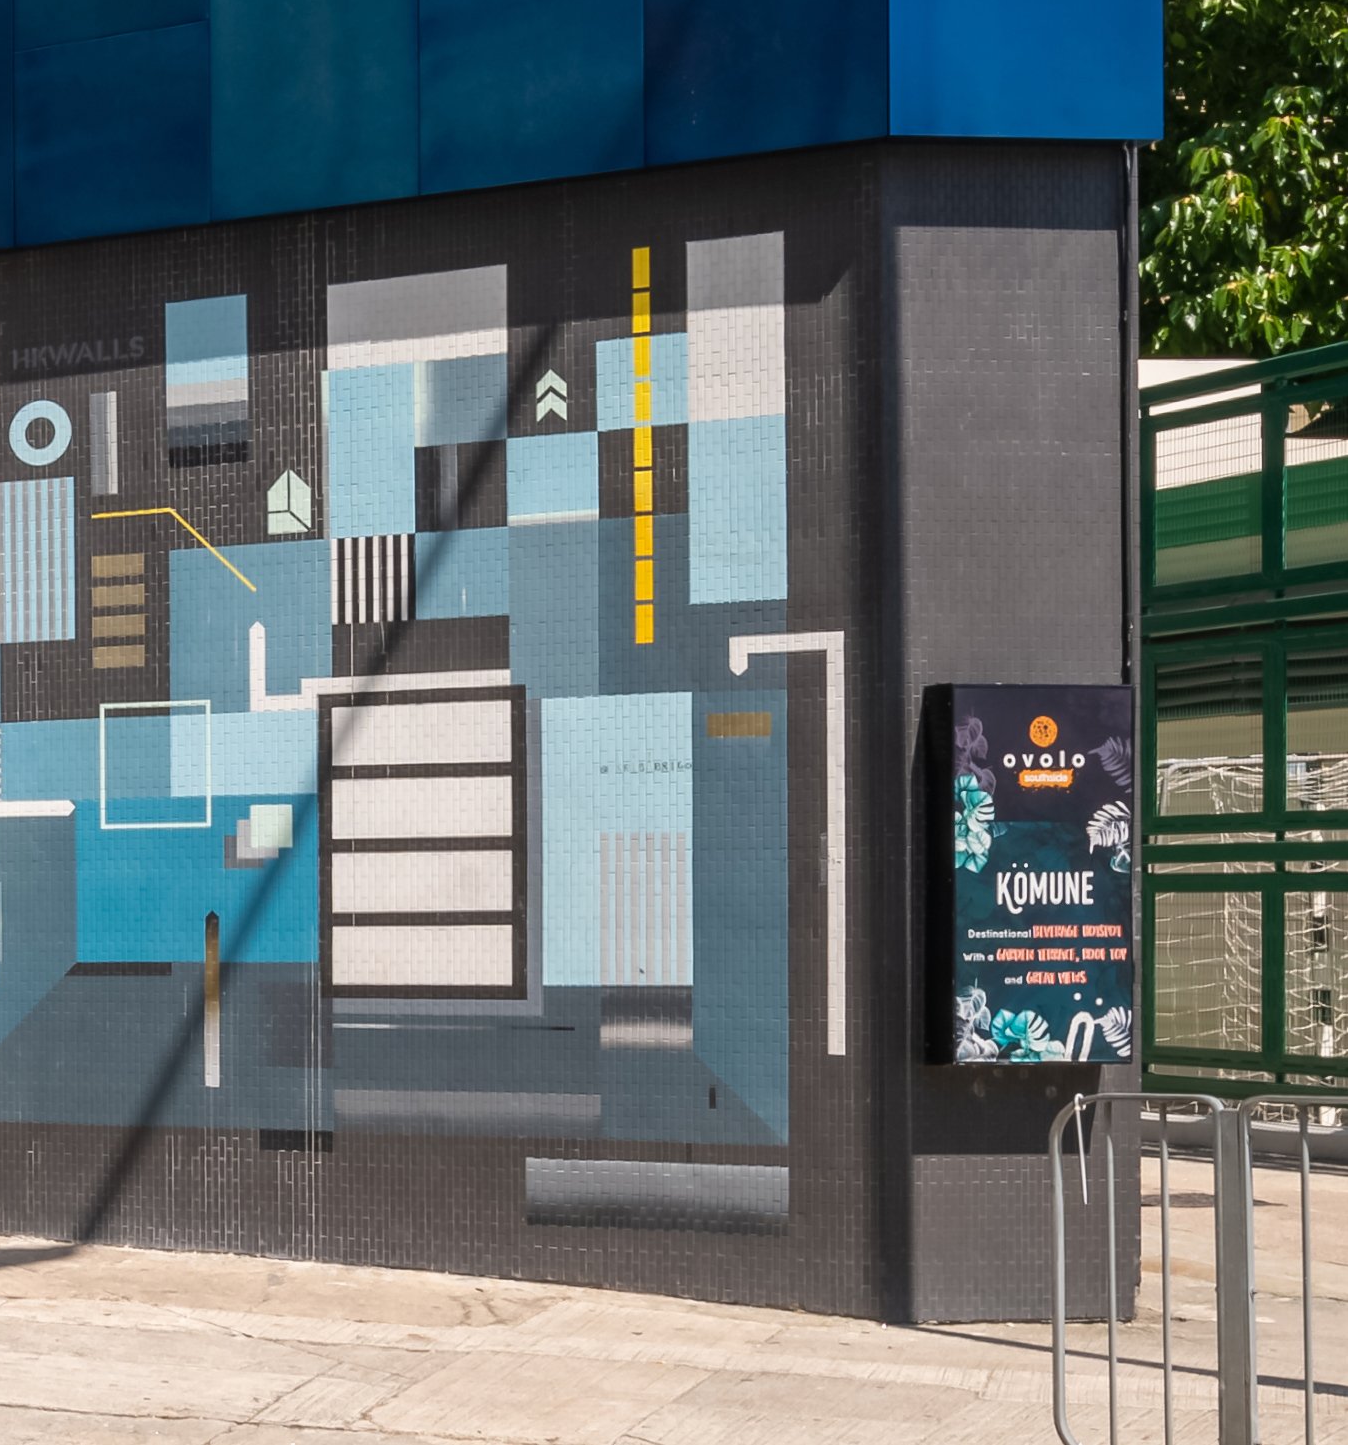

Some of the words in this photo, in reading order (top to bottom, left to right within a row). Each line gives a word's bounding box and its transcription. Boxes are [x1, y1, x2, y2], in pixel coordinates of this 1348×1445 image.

[12, 335, 145, 371] HKWALLS
[1003, 749, 1086, 768] ovolo
[997, 862, 1094, 914] KÖMUNE
[968, 928, 1032, 939] Destinational
[987, 954, 994, 962] a
[1004, 975, 1023, 985] and
